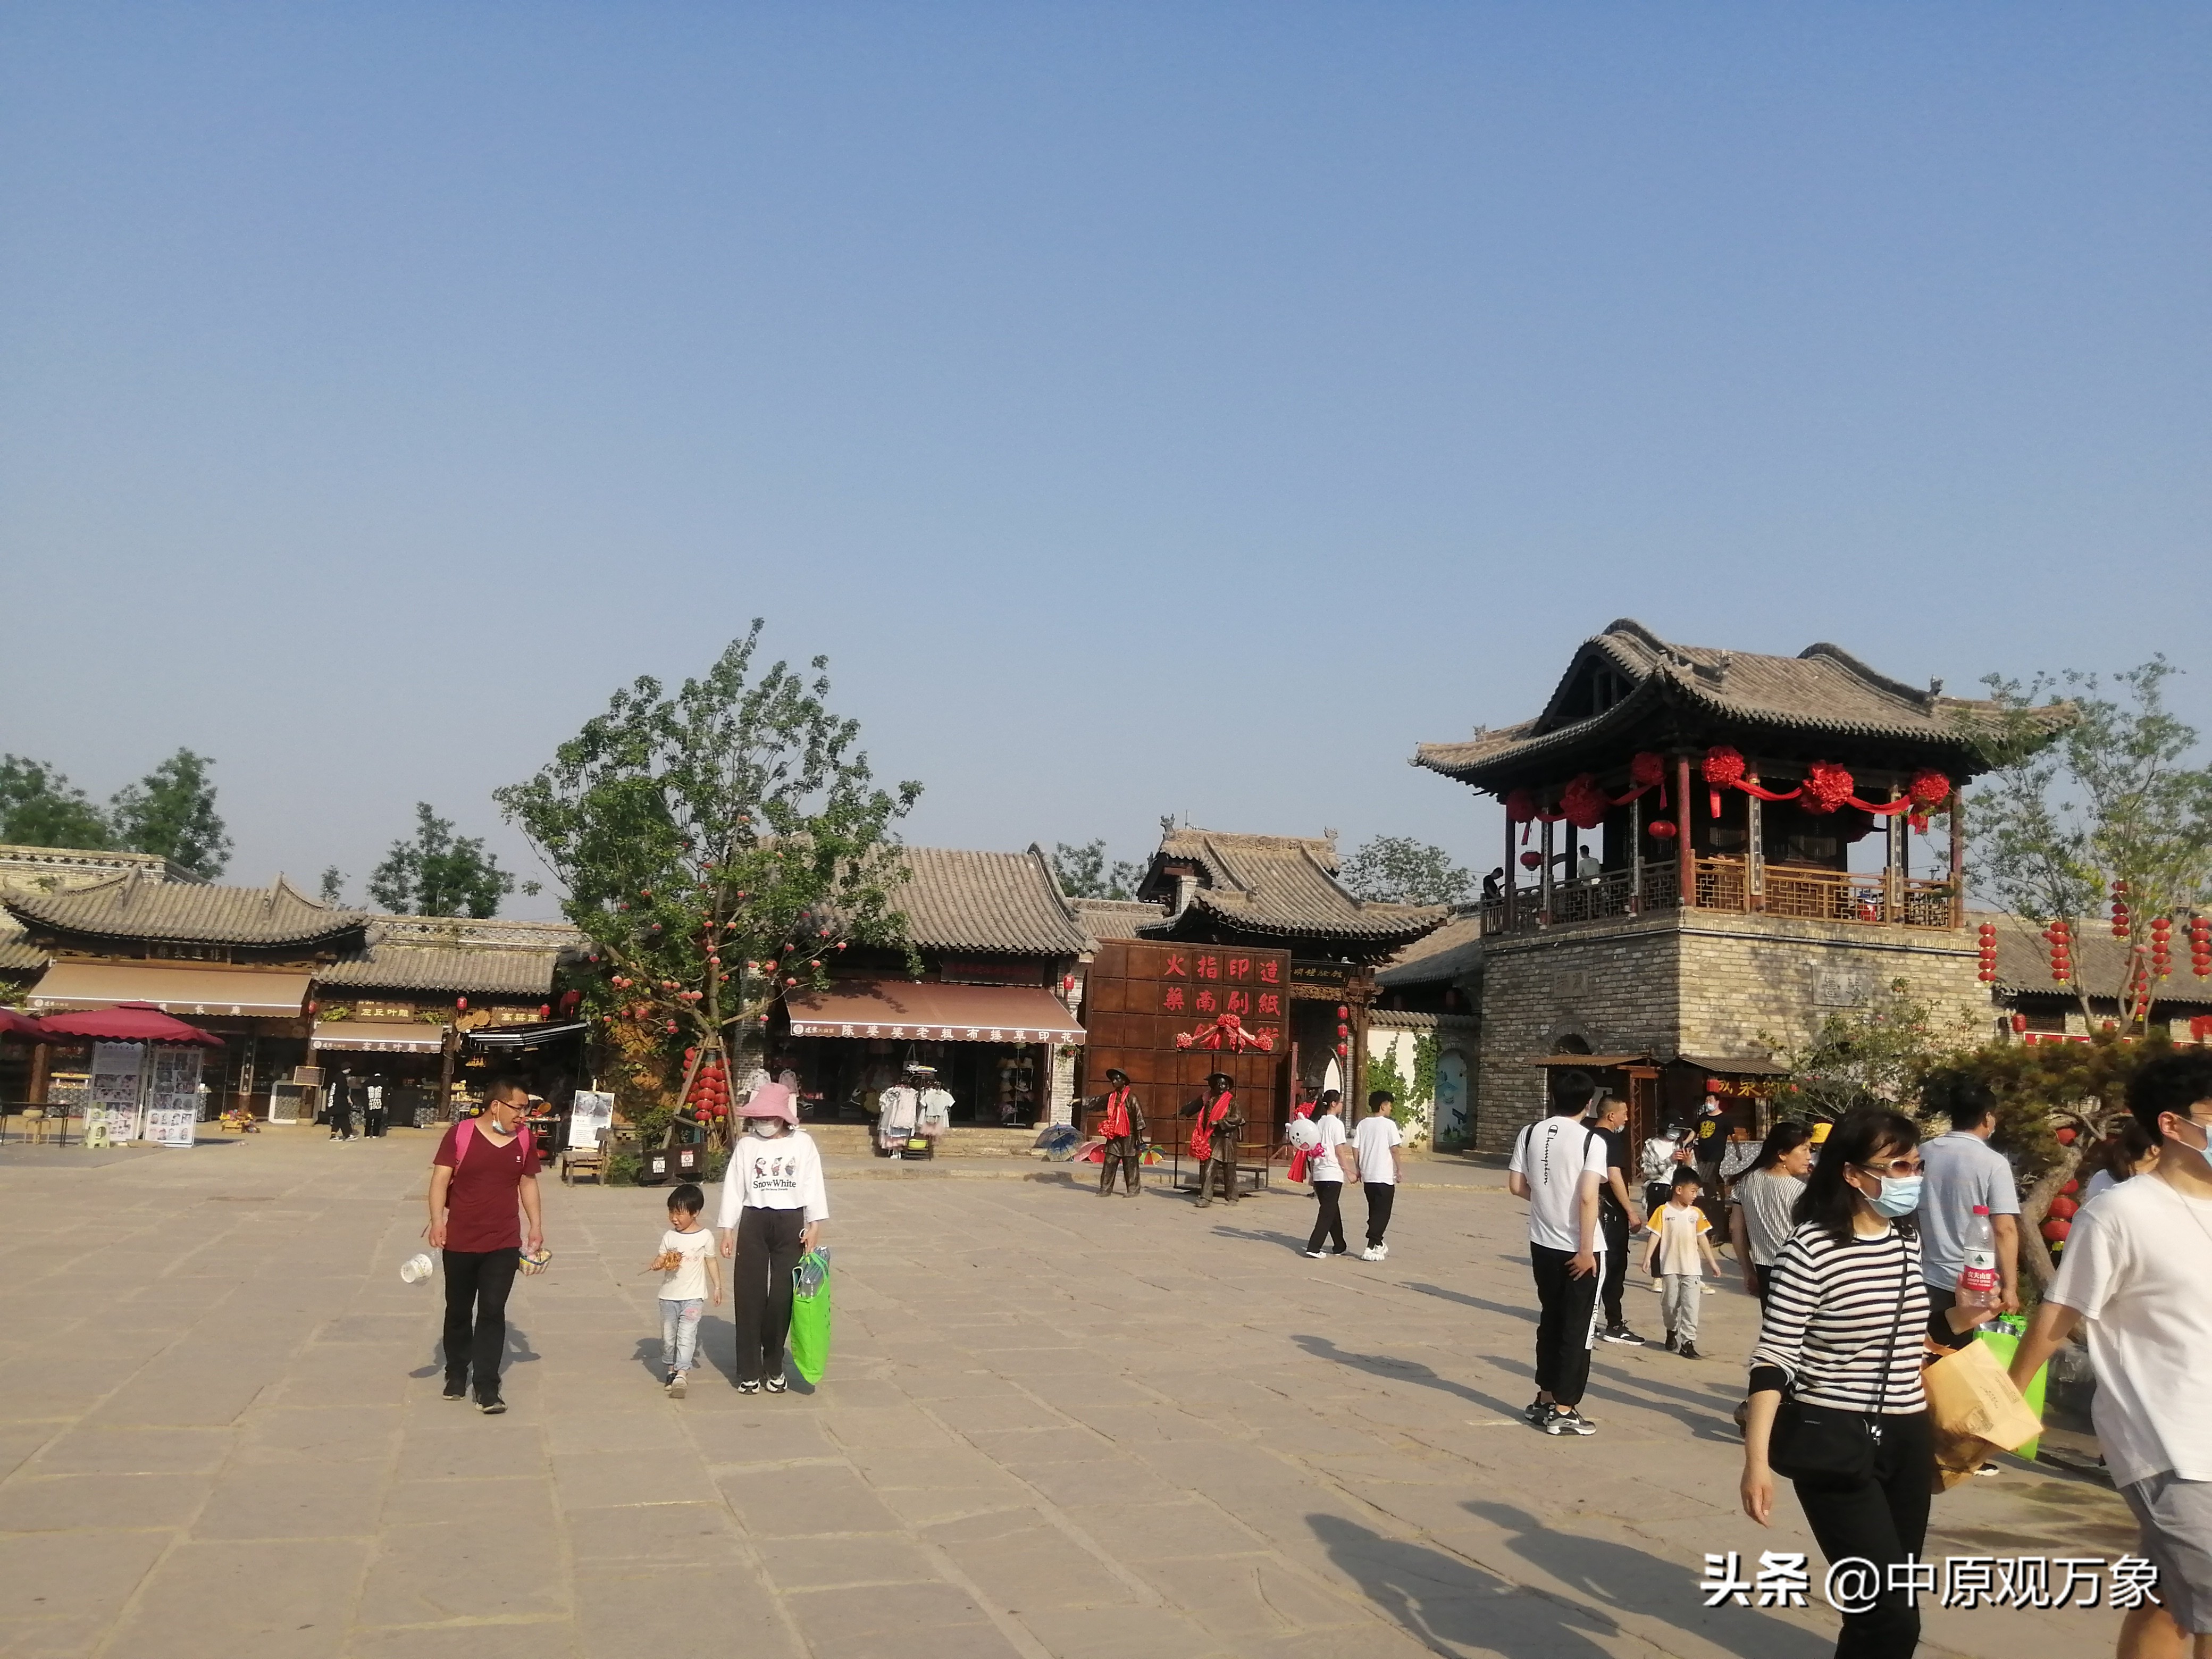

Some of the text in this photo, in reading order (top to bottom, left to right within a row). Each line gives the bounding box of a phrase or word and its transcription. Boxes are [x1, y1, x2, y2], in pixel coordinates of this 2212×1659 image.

[361, 1008, 409, 1017] 左丘叶雕
[841, 1024, 1074, 1043] 陈婆婆老粗布捶草印花
[362, 1042, 417, 1052] 左丘叶雕
[1540, 1124, 1559, 1186] Champion
